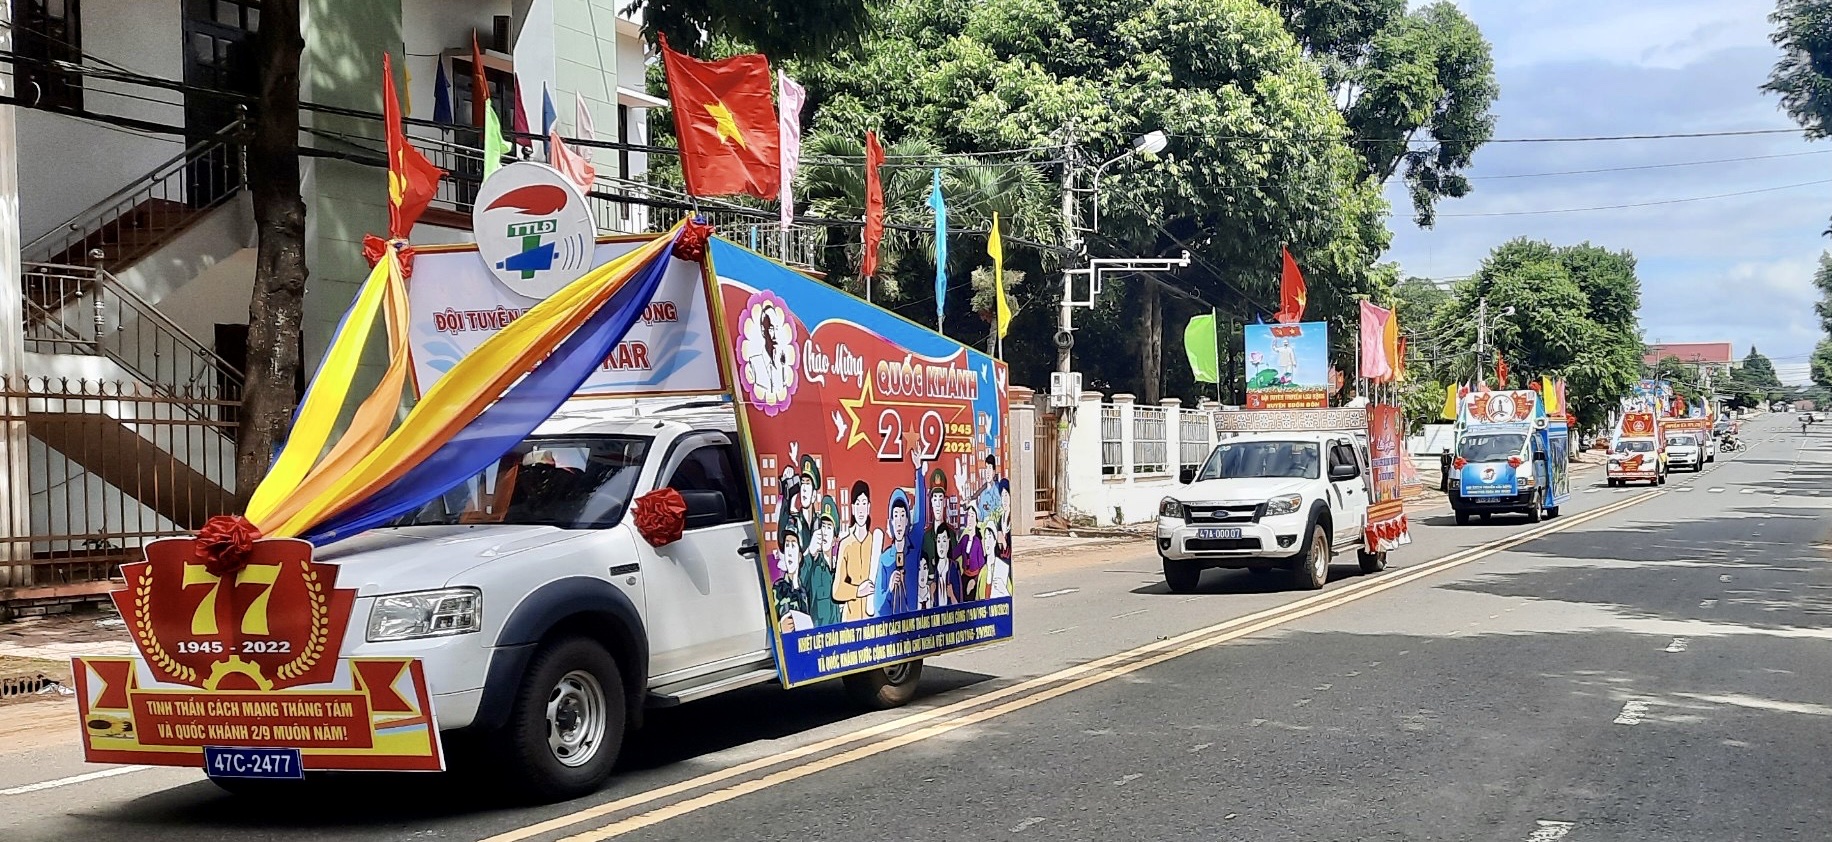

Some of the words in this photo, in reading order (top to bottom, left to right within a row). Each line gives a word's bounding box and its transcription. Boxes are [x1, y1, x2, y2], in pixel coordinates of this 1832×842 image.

[511, 221, 555, 236] TTLĐ
[434, 307, 466, 335] ĐỘI
[876, 353, 923, 397] QUỐC
[925, 362, 978, 400] KHÁNH
[944, 424, 972, 435] 1945
[943, 442, 972, 453] 2022
[181, 561, 283, 636] 77
[177, 640, 223, 654] 1945
[242, 641, 291, 654] 2022
[146, 701, 173, 716] TINH
[207, 699, 240, 717] CÁCH
[242, 702, 279, 720] MẠNG
[281, 699, 323, 717] THÁNG
[325, 699, 353, 718] TÁM
[157, 721, 174, 738] VÀ
[175, 719, 206, 740] QUỐC
[207, 722, 249, 740] KHÁNH
[251, 725, 271, 740] 2/9
[272, 722, 311, 740] MUÔN
[312, 722, 348, 741] NĂM!
[214, 753, 291, 773] 47C-2477
